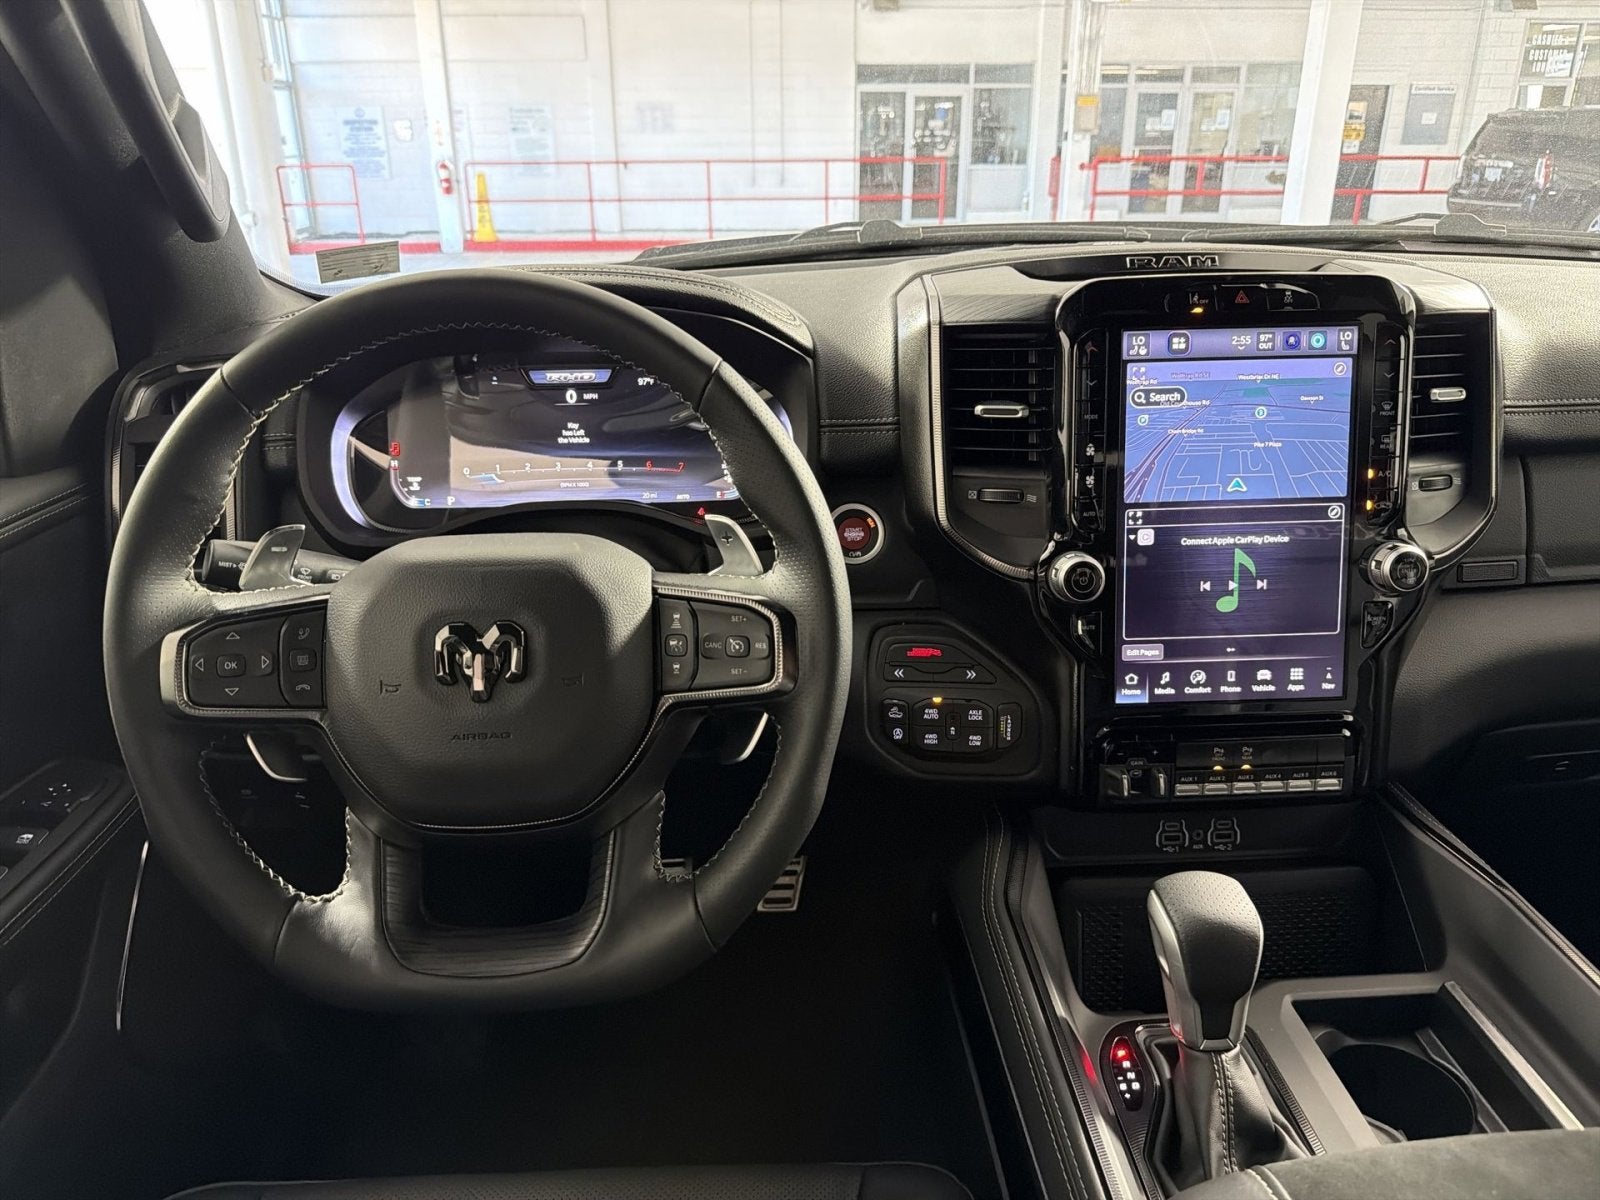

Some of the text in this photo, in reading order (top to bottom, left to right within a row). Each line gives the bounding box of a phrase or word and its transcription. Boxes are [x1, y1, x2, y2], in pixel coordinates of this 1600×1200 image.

[1126, 255, 1220, 269] RAM
[1132, 336, 1146, 345] LO
[1231, 335, 1251, 346] 2:55
[1340, 331, 1351, 341] LO
[1258, 342, 1272, 350] OUT
[565, 389, 577, 404] 0
[1149, 391, 1181, 402] Search
[524, 463, 531, 471] 2
[587, 461, 593, 469] 4
[617, 460, 623, 468] 5
[646, 460, 652, 468] 6
[678, 462, 685, 471] 7
[446, 496, 456, 505] P
[1181, 534, 1290, 546] Connect Apple CarPlay Device
[224, 661, 238, 670] OK
[1184, 686, 1212, 694] Comfort
[1252, 684, 1276, 692] Vehicle
[1322, 682, 1335, 690] Nav
[451, 731, 513, 741] AIRBAG
